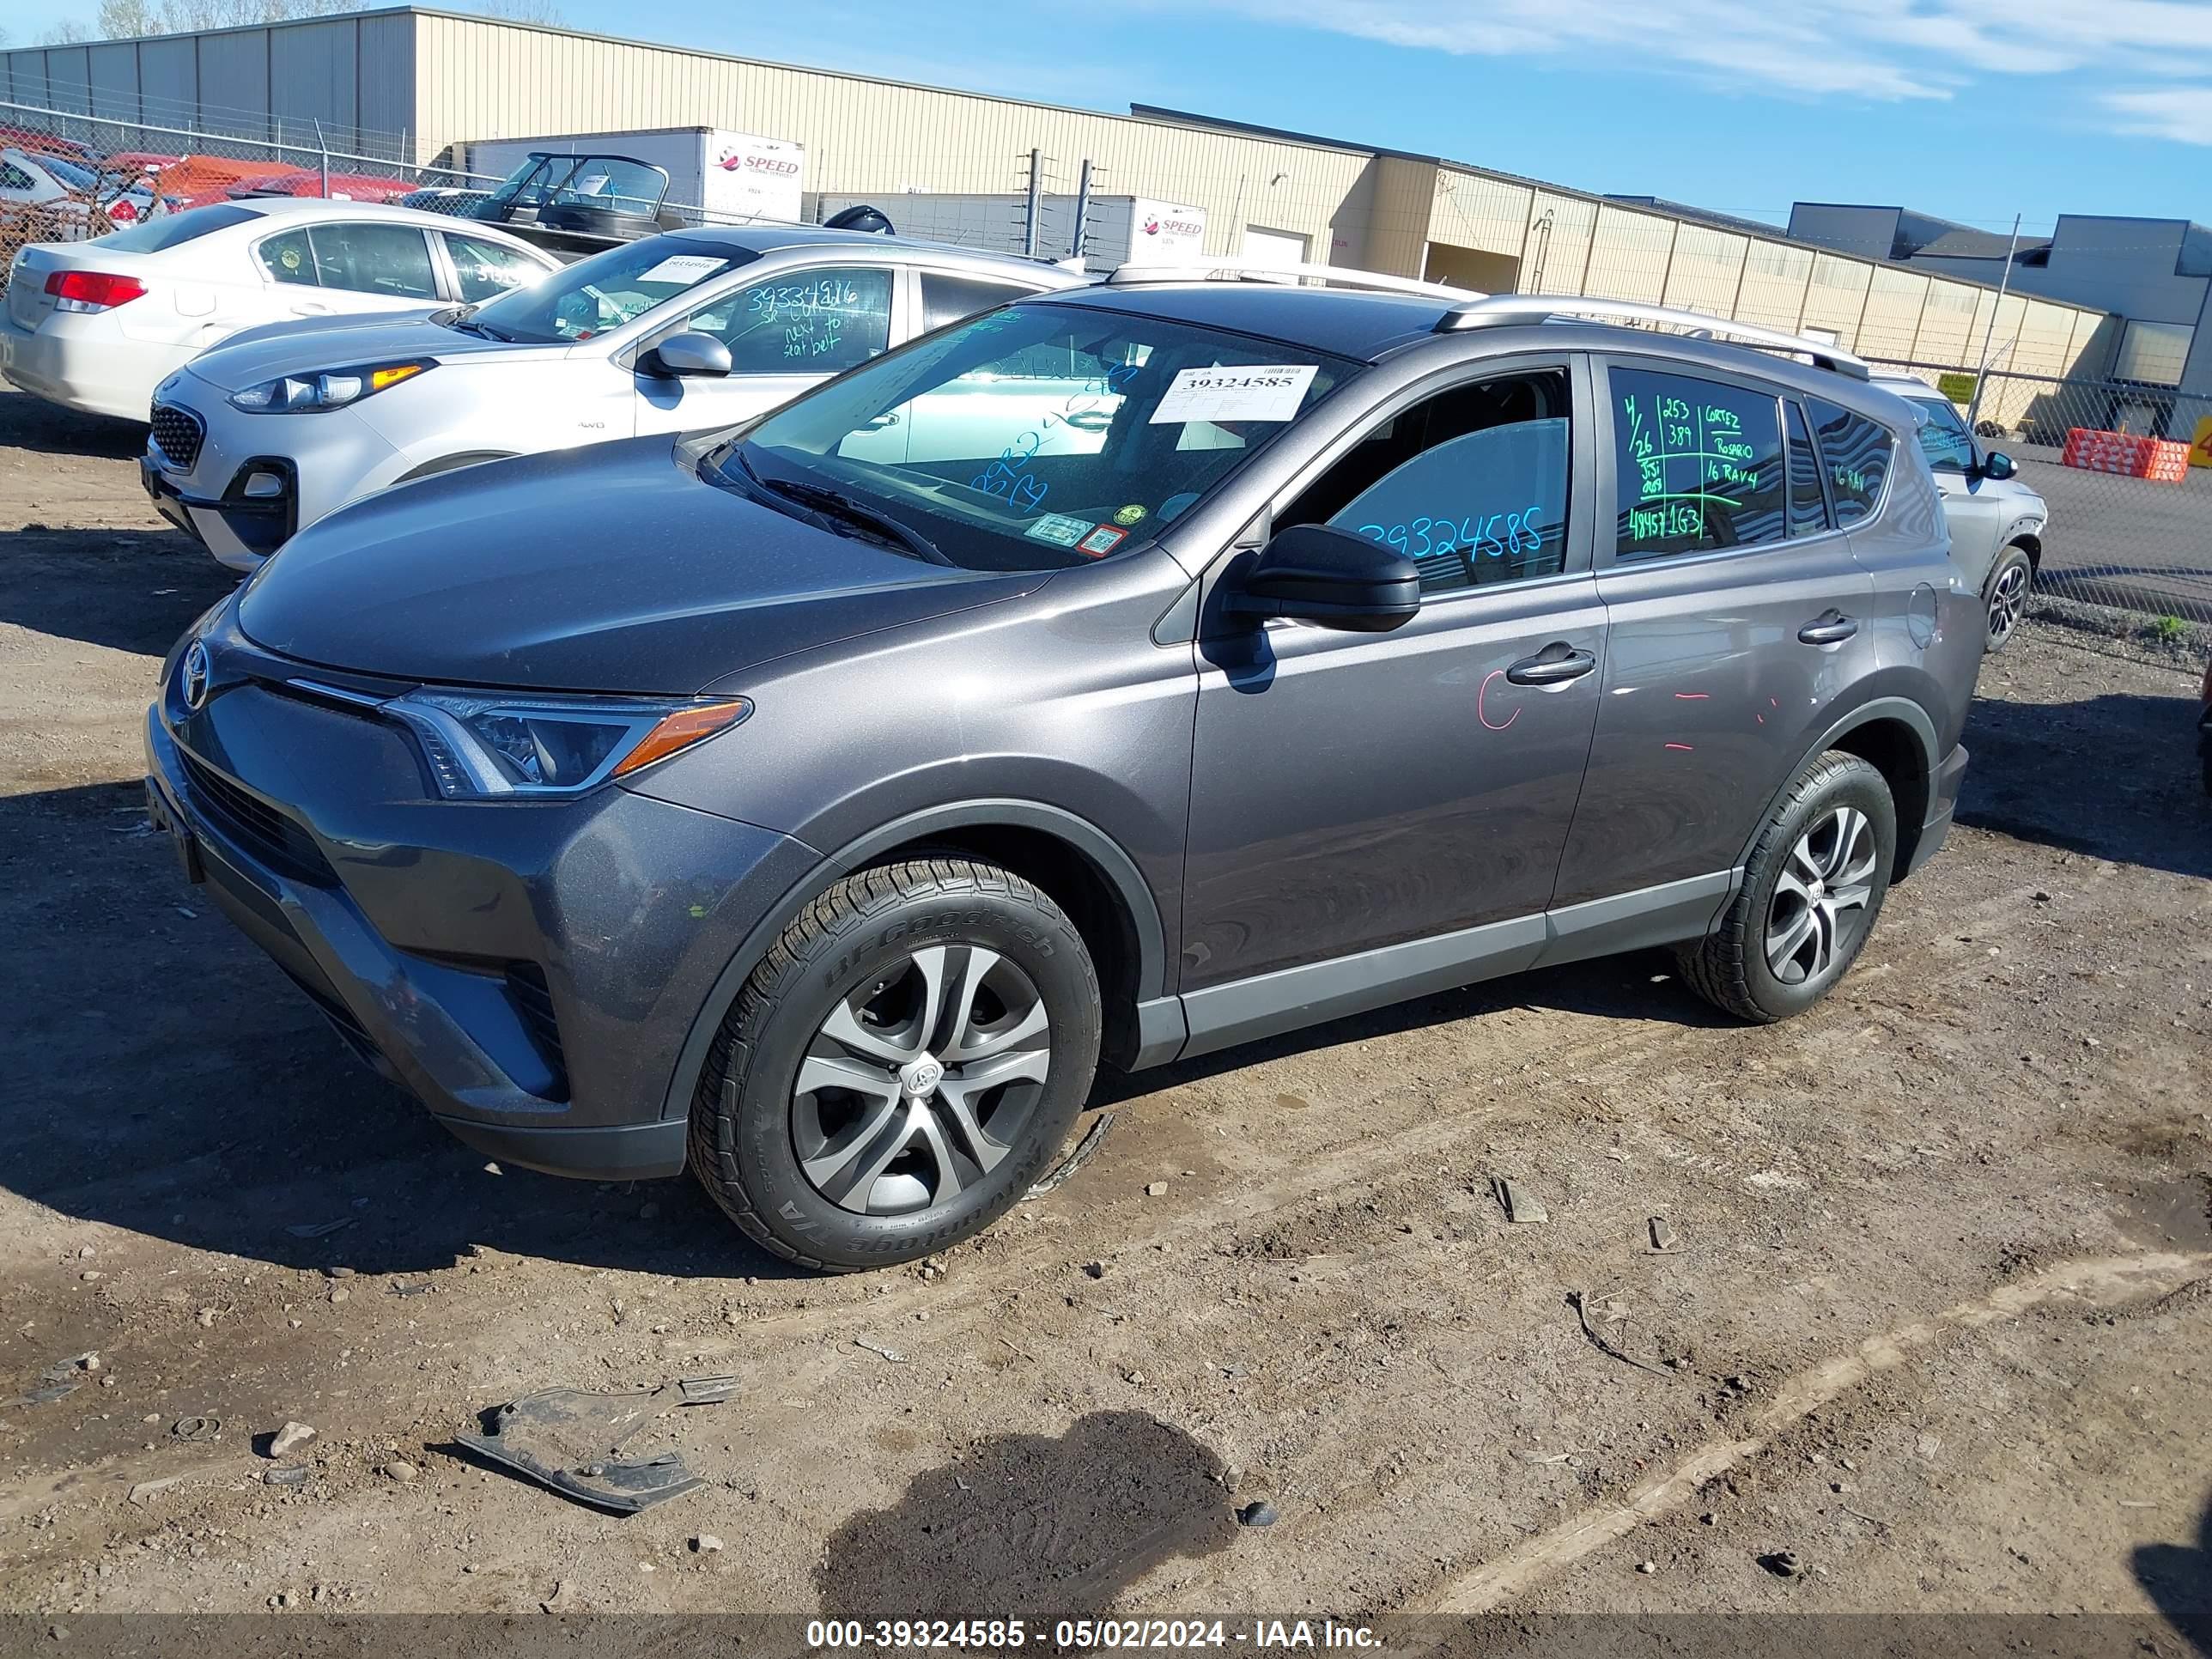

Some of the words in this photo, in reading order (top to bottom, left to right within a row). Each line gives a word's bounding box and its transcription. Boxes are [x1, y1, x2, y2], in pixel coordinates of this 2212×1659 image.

[744, 155, 799, 174] SPEED
[1162, 220, 1202, 234] SPEED
[824, 313, 841, 331] to
[783, 341, 806, 358] seat
[811, 331, 842, 356] belt
[1182, 377, 1294, 390] 39324585
[1662, 398, 1690, 420] 253
[1705, 404, 1741, 428] CORTEZ
[1668, 424, 1692, 447] 389
[1707, 459, 1718, 480] 16
[1723, 464, 1758, 489] RAV4
